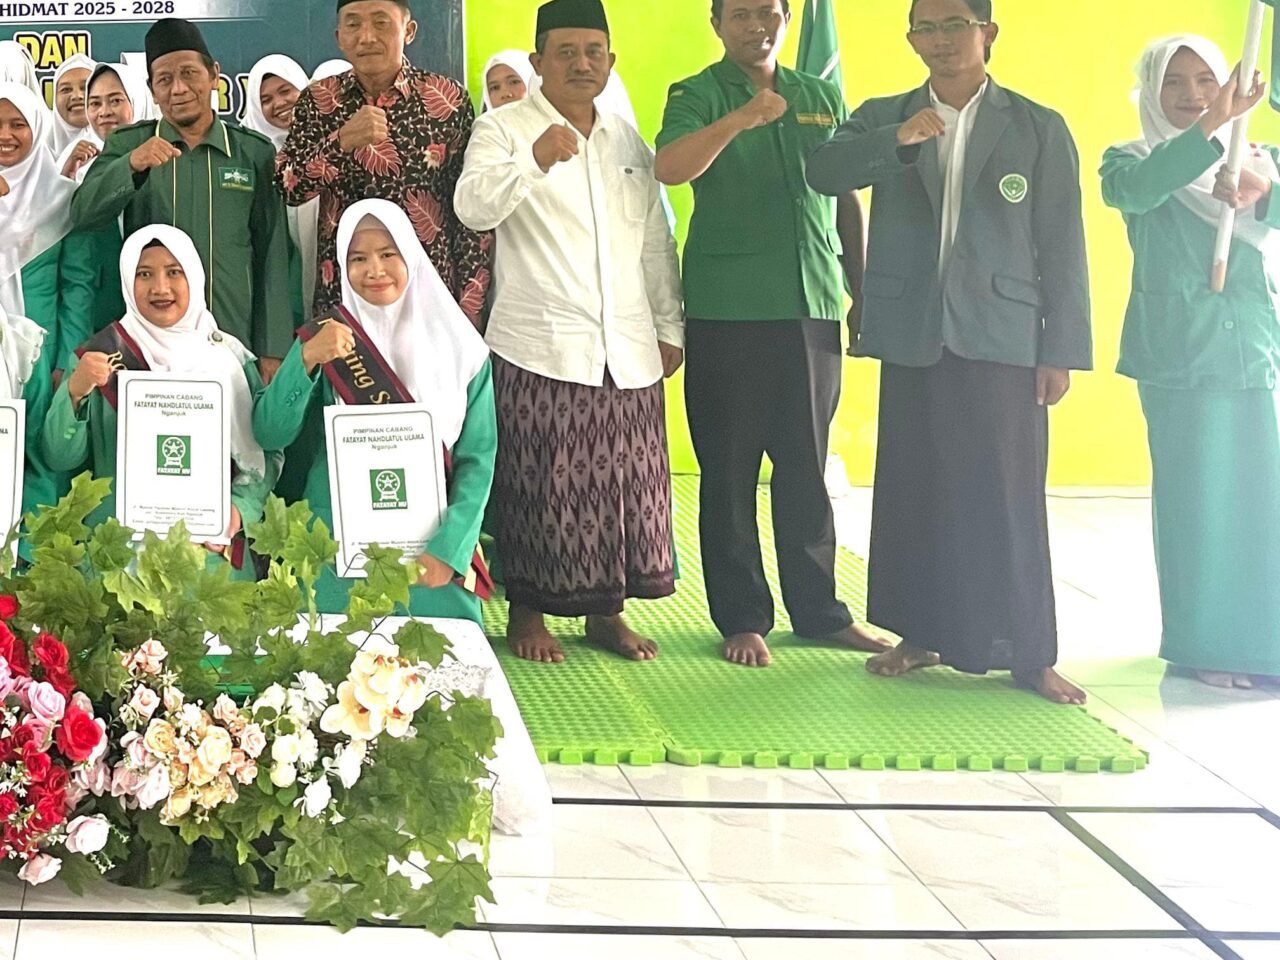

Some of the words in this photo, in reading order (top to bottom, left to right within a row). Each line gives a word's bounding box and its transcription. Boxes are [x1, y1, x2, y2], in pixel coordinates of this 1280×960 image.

[74, 1, 116, 15] 2025
[132, 0, 175, 14] 2028
[17, 33, 88, 69] DAN
